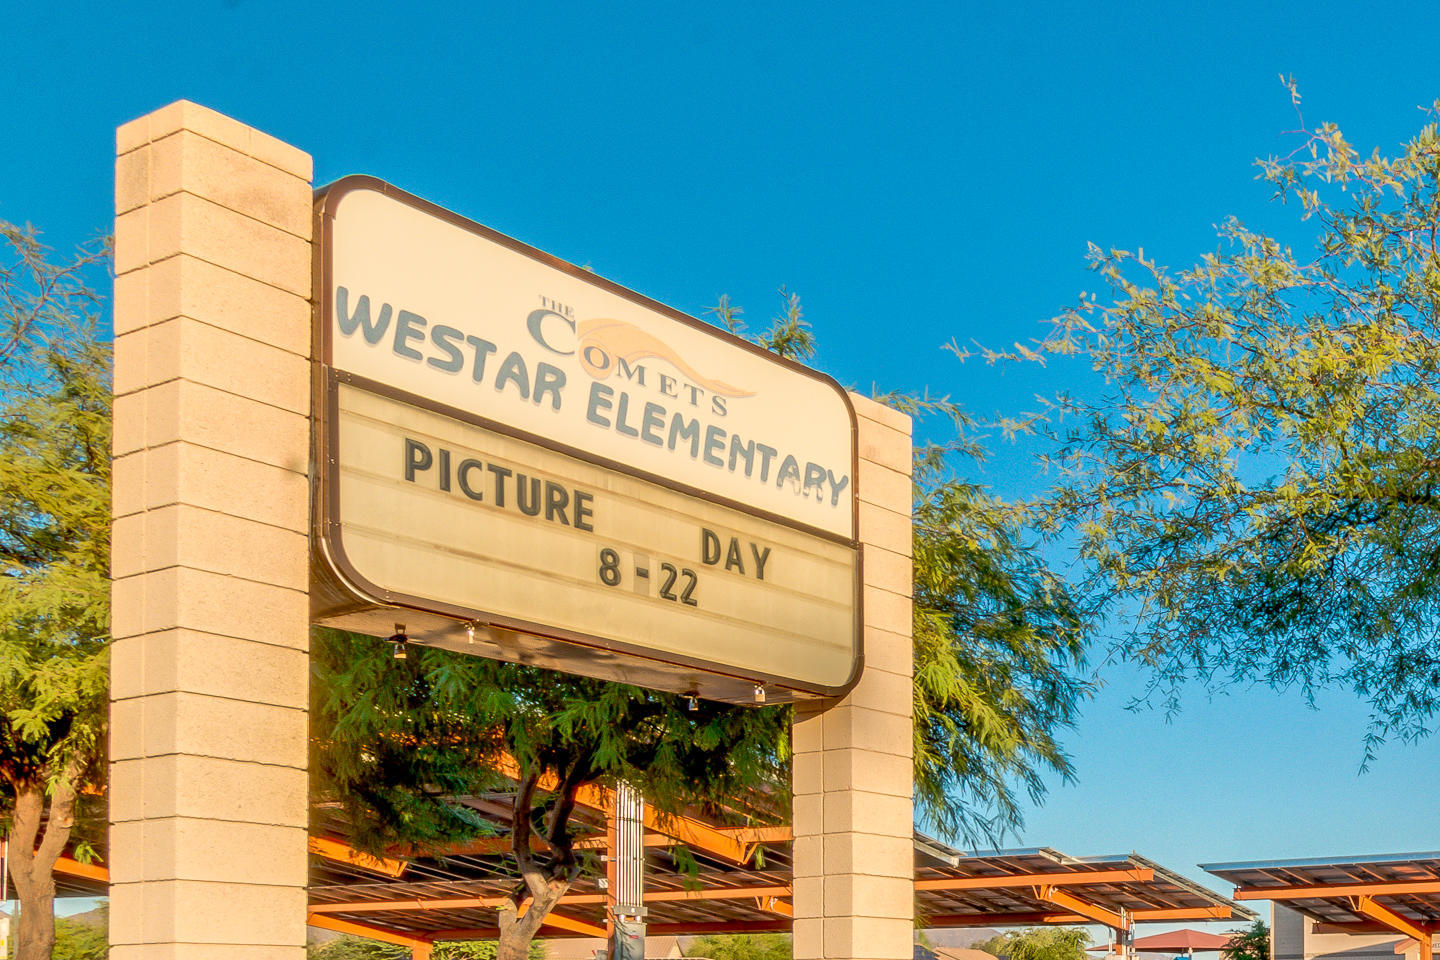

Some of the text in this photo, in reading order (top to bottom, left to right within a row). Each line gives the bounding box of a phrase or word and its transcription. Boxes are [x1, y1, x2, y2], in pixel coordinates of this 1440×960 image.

[527, 309, 729, 417] COMETS
[539, 295, 575, 319] THE
[336, 285, 850, 507] WESTAR ELEMENTARY
[404, 437, 771, 580] PICTURE DAY
